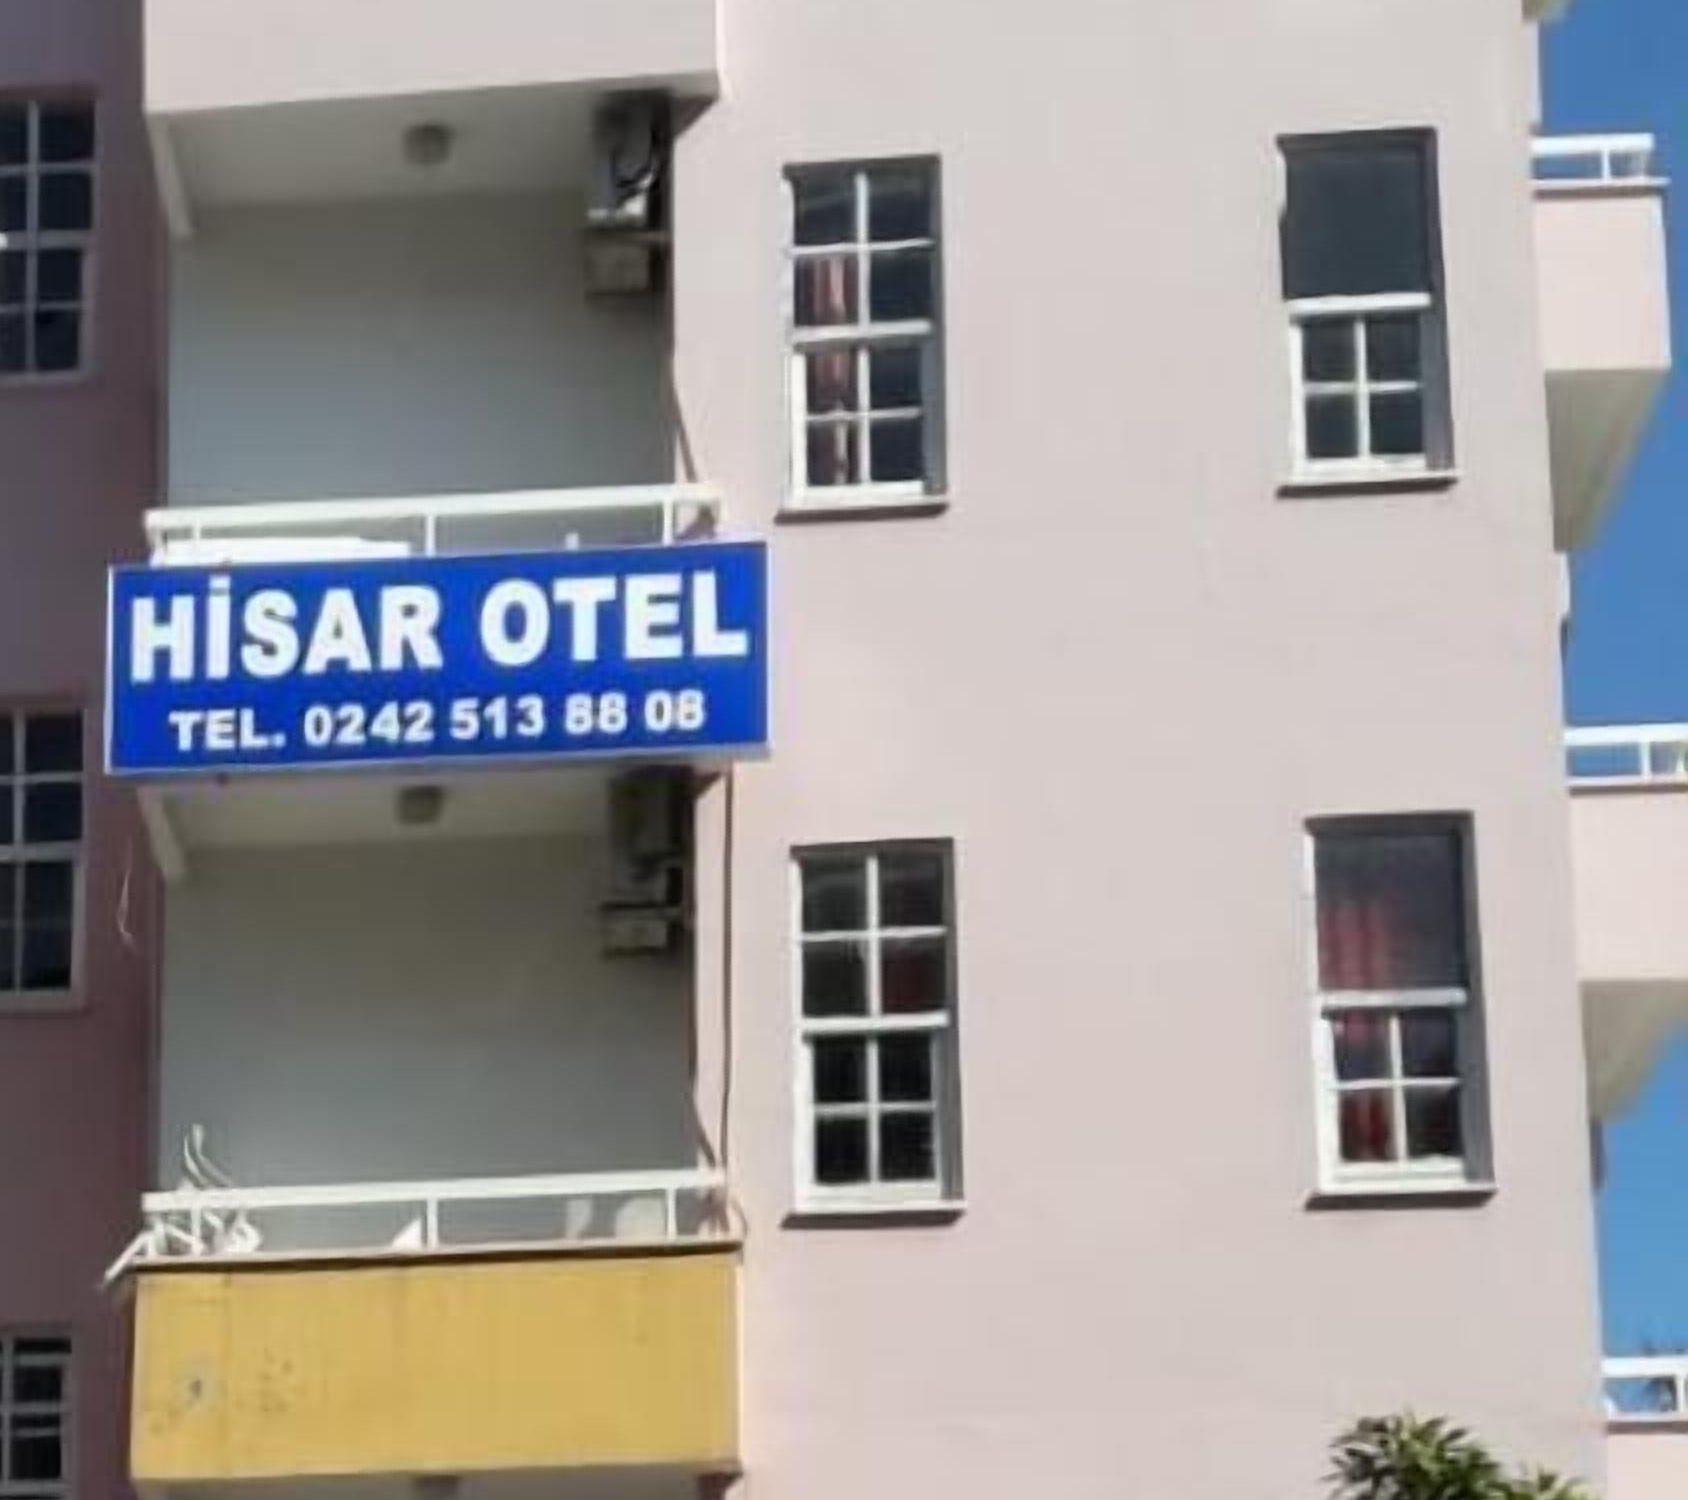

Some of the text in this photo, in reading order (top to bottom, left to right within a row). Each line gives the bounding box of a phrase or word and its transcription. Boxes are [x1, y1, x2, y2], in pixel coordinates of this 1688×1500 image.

[131, 571, 749, 683] HİSAR OTEL
[168, 689, 706, 751] TEL. 0242 513 88 08
